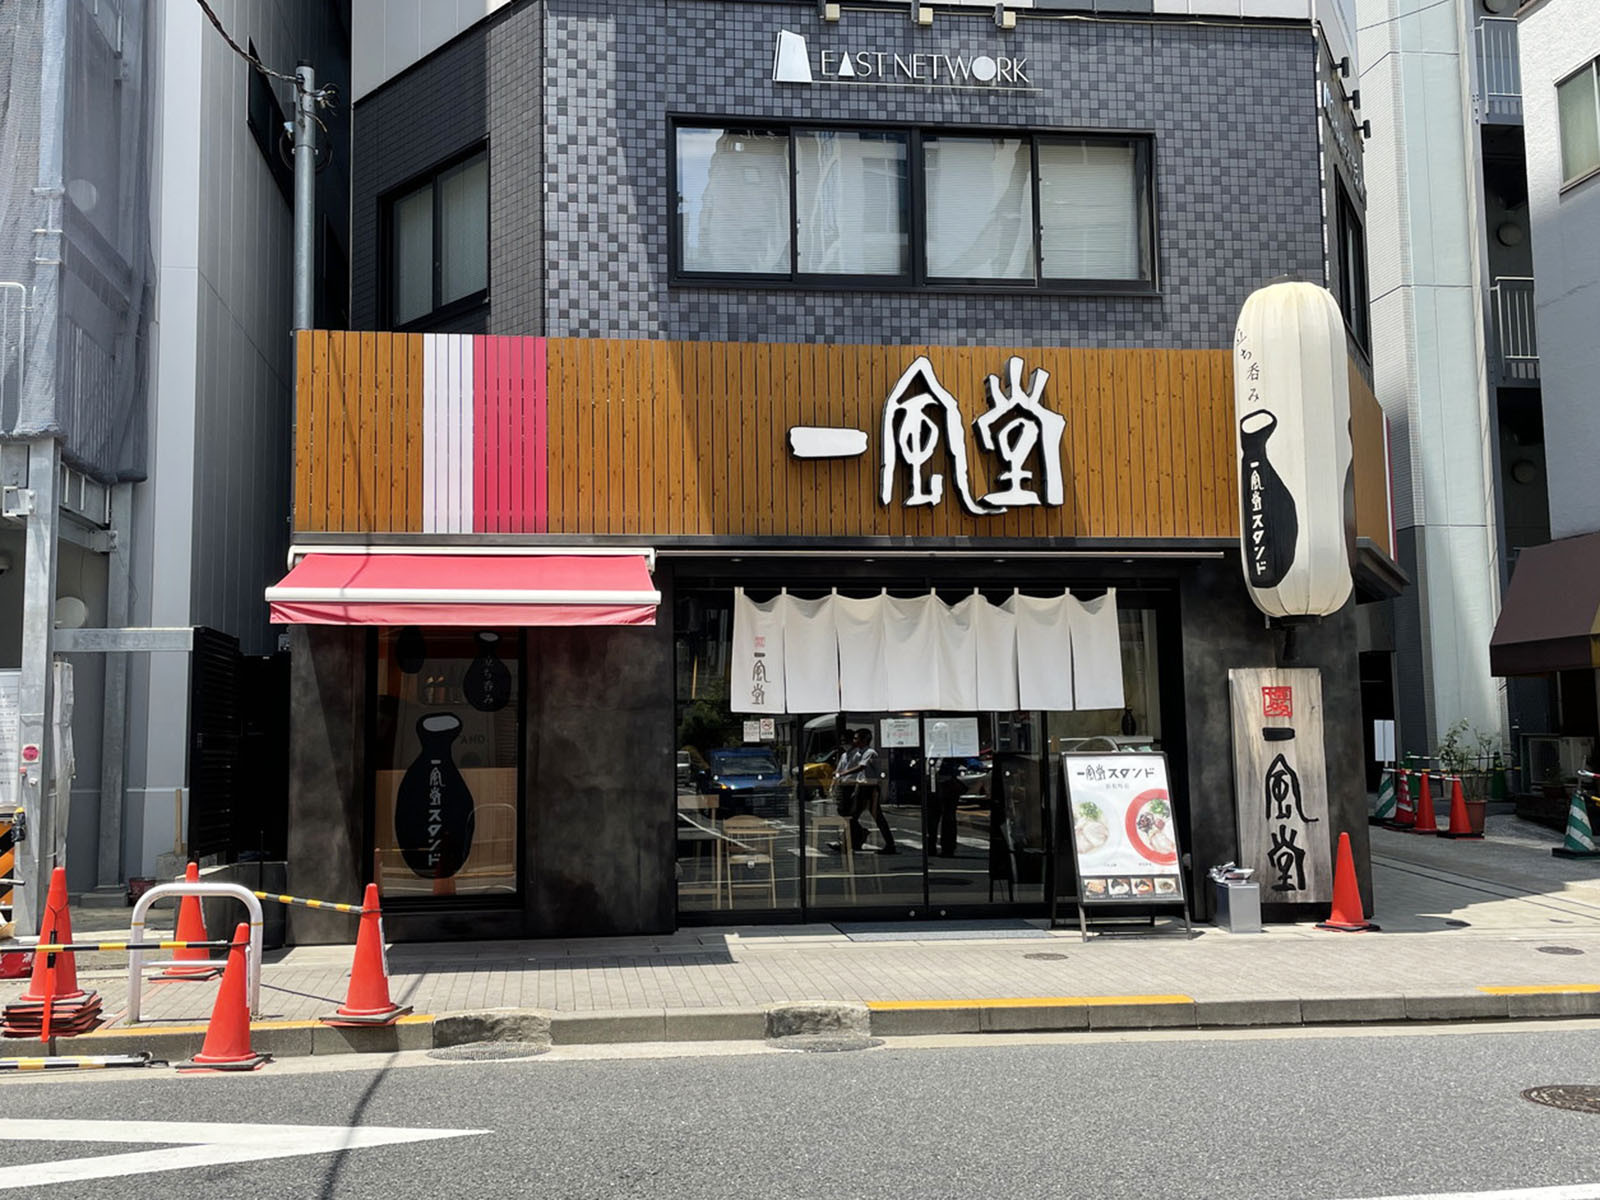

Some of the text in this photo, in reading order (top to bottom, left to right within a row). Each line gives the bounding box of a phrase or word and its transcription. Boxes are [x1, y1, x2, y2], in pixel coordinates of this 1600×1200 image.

[788, 355, 1067, 516] 一風堂
[1250, 461, 1266, 576] 一風堂スタンド
[428, 759, 446, 866] 一風堂スタンド
[1261, 727, 1320, 891] 一風堂
